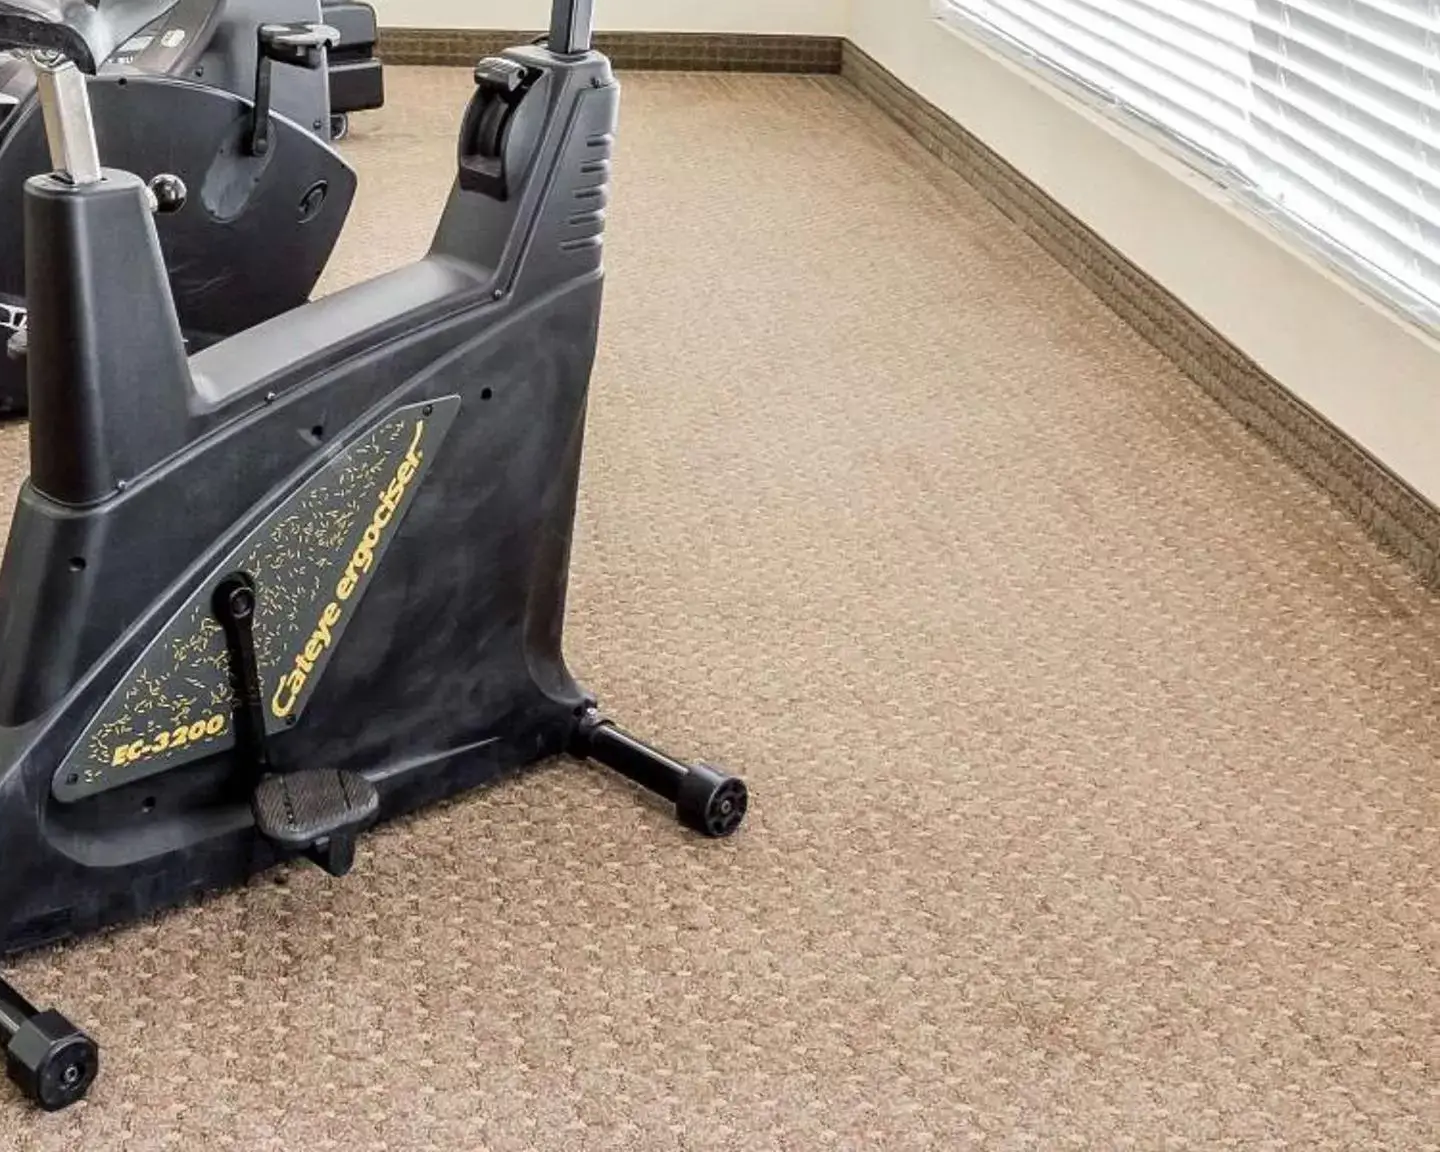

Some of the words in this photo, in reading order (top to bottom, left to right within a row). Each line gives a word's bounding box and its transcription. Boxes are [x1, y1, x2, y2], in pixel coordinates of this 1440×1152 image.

[271, 601, 342, 717] Cateye
[336, 419, 425, 600] ergociser
[110, 713, 225, 767] EC-3200
